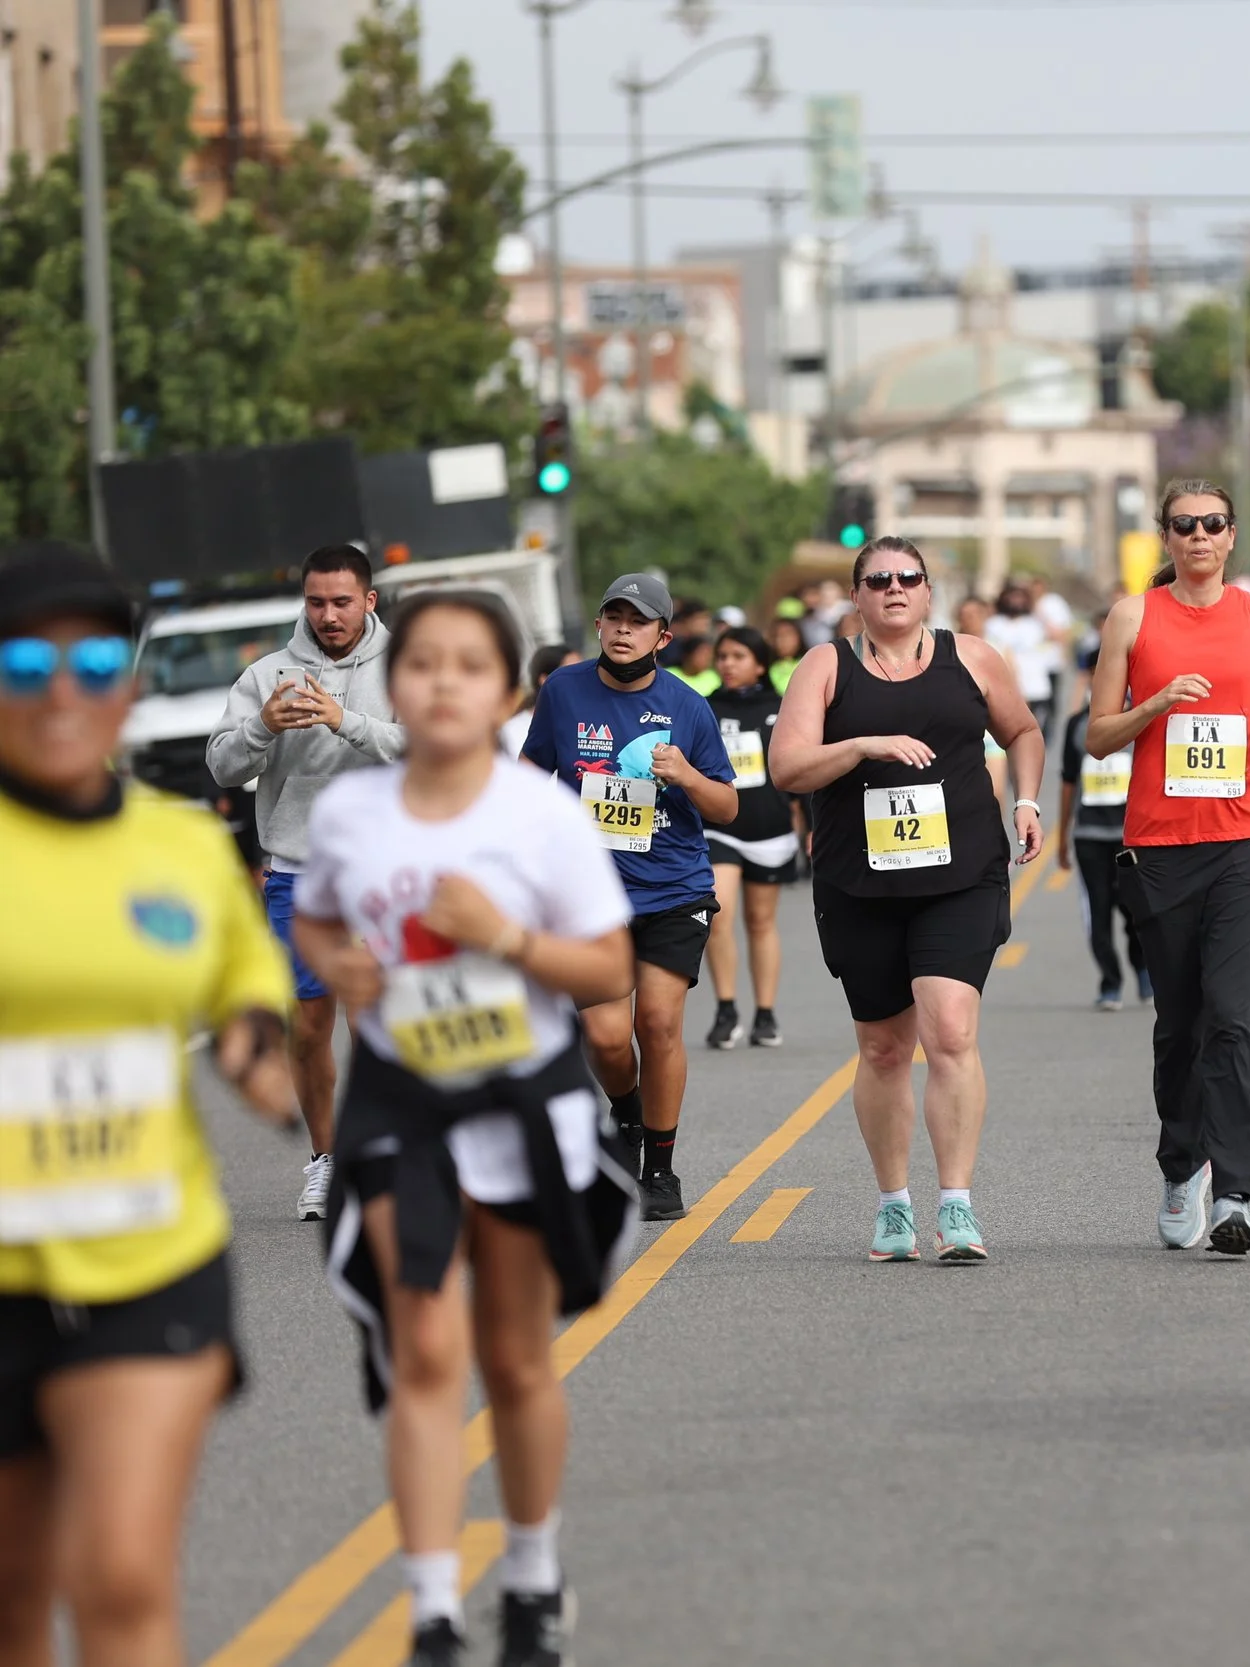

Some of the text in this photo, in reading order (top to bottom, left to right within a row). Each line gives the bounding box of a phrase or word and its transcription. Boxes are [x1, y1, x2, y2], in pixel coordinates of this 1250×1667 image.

[1192, 727, 1219, 743] LA
[578, 744, 613, 752] MARATHON
[1187, 747, 1226, 769] 691
[604, 785, 629, 802] LA
[1227, 788, 1241, 796] 691
[592, 802, 642, 827] 1295
[889, 799, 917, 816] LA
[893, 818, 921, 841] 42
[628, 842, 647, 851] 1295
[878, 856, 911, 866] Tracy B
[937, 855, 947, 863] 42
